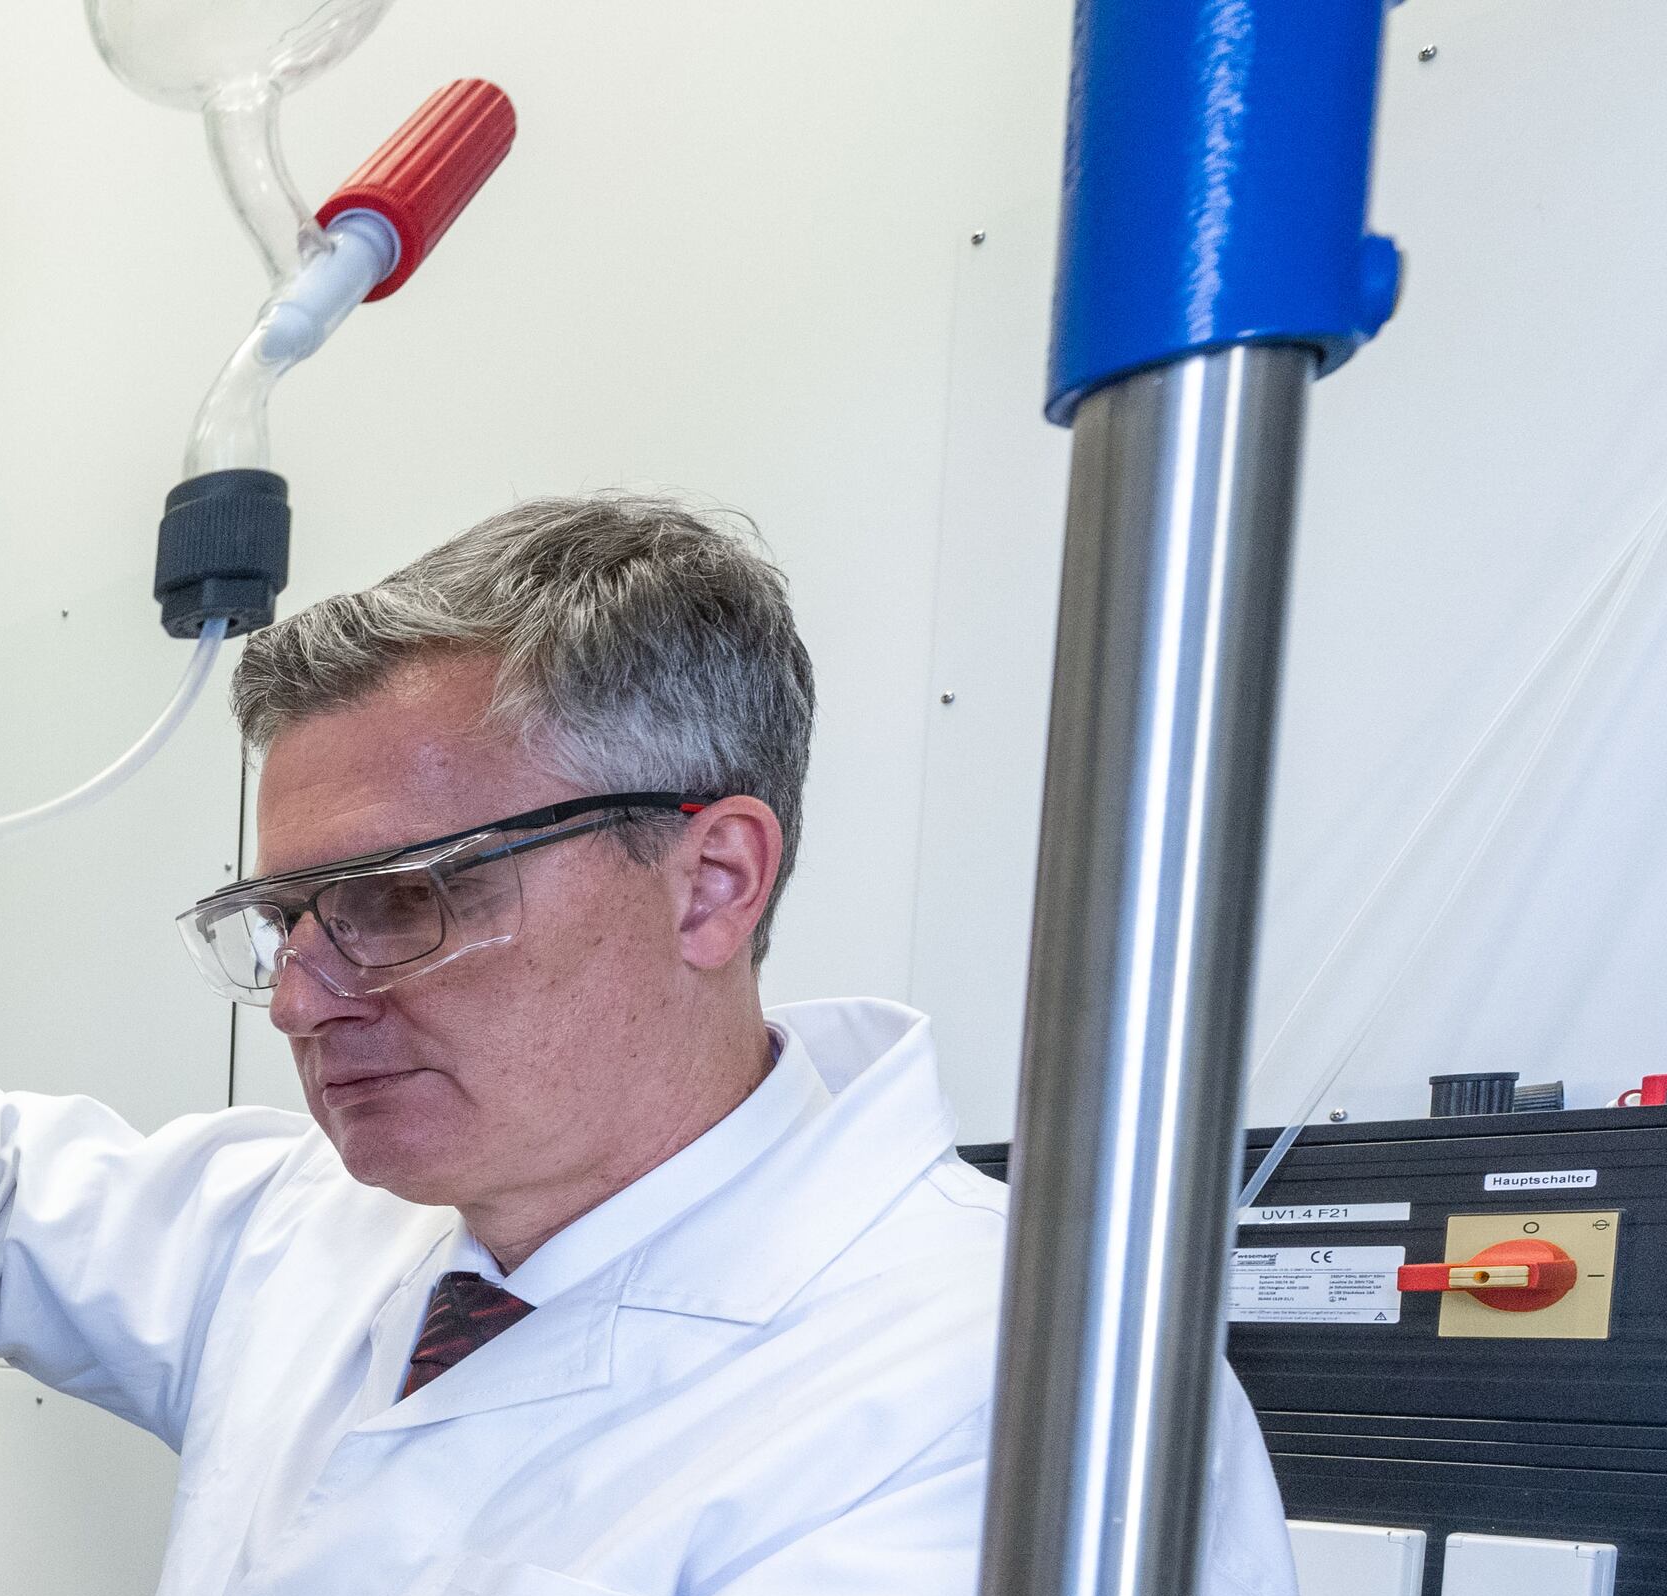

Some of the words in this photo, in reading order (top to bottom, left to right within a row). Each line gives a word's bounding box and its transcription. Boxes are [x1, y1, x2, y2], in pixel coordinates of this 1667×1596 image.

[1492, 1173, 1591, 1187] Hauptschalter
[1261, 1207, 1313, 1221] UV1.4
[1317, 1206, 1349, 1219] F21
